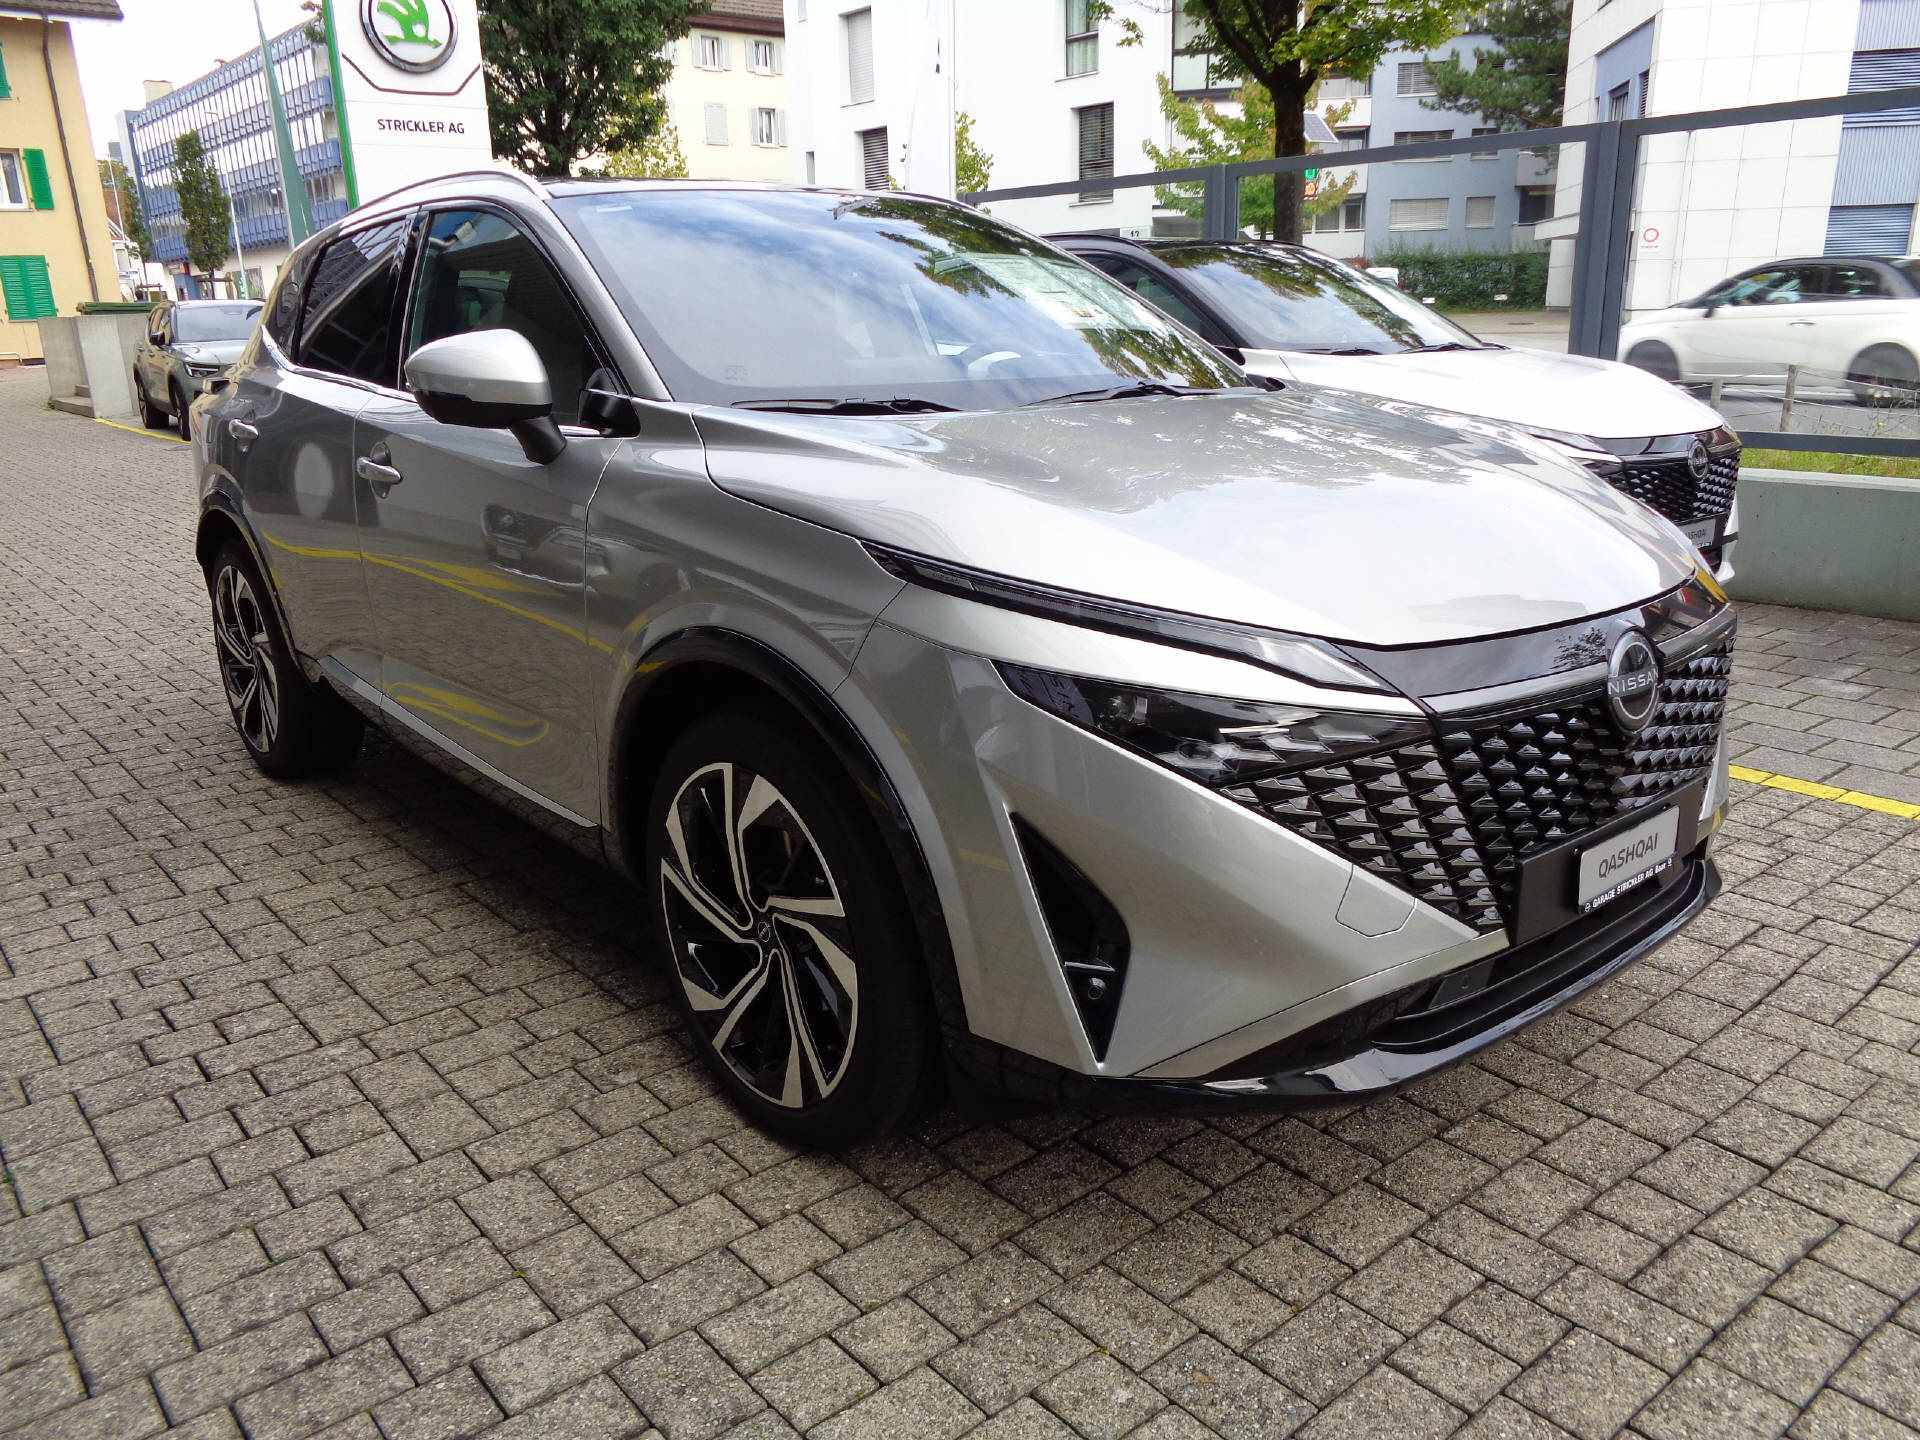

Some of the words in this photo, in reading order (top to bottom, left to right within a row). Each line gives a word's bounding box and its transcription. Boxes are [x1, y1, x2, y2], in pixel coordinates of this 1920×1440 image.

[377, 119, 445, 133] STRICKLER
[448, 121, 465, 134] AG
[1607, 670, 1659, 695] NISSAN
[1598, 832, 1659, 879] QASHQAI
[1592, 888, 1616, 908] GARAGE
[1616, 873, 1645, 895] STRICKLER
[1645, 868, 1654, 879] AG
